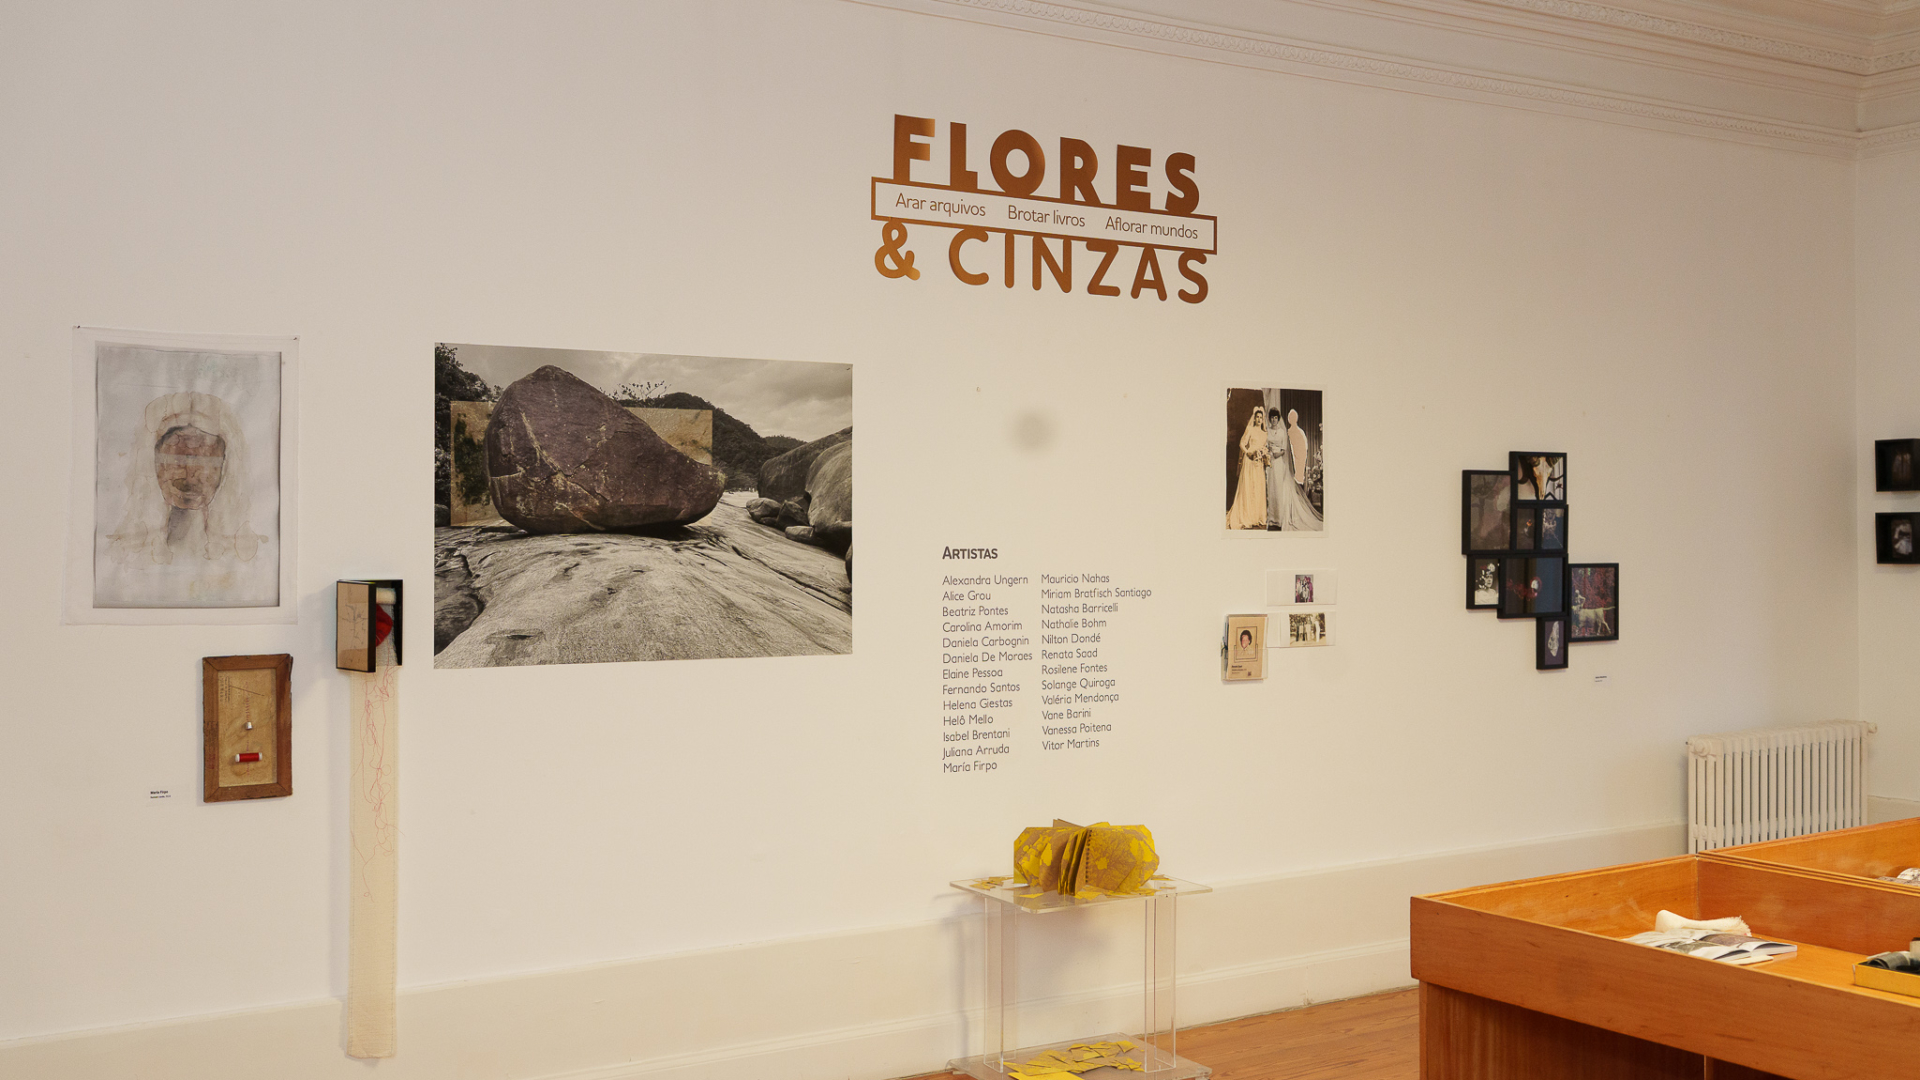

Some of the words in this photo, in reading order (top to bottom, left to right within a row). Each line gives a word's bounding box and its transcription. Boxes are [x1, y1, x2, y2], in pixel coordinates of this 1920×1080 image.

[894, 114, 1200, 214] FLORES
[895, 193, 926, 210] Arar
[929, 198, 986, 218] arquivos
[1008, 205, 1050, 223] Brotar
[1053, 209, 1085, 227] livros
[1105, 216, 1147, 234] Aflorar
[1150, 223, 1198, 240] mundos
[874, 220, 921, 281] &
[949, 228, 1209, 304] CINZAS
[942, 575, 990, 585] Alexandra
[994, 575, 1028, 587] Ungern
[1082, 573, 1109, 583] Nahas
[942, 591, 964, 601] Alice
[967, 590, 991, 600] Grou
[1041, 589, 1071, 599] Miriam
[1075, 588, 1112, 598] Bratfisch
[1115, 588, 1152, 599] Santiago
[943, 606, 976, 617] Beatriz
[979, 605, 1008, 616] Pontes
[1042, 604, 1079, 614] Natasha
[1082, 603, 1118, 613] Barricelli
[943, 622, 981, 632] Carolina
[984, 620, 1022, 631] Amorim
[1042, 619, 1079, 629] Nathalie
[1082, 618, 1106, 628] Bohm
[943, 637, 978, 648] Daniela
[1042, 634, 1068, 644] Nilton
[1071, 633, 1101, 643] Dondé
[943, 653, 978, 663] Daniela
[982, 652, 995, 662] De
[999, 651, 1032, 661] Moraes
[1042, 650, 1073, 660] Renata
[1076, 648, 1097, 658] Saad
[943, 669, 969, 679] Elaine
[972, 668, 1003, 678] Pessoa
[1042, 664, 1077, 675] Rosilene
[1080, 663, 1107, 673] Fontes
[943, 683, 987, 695] Fernando
[990, 682, 1020, 692] Santos
[1042, 680, 1077, 691] Solange
[1080, 678, 1115, 689] Quiroga
[943, 700, 976, 710] Helena
[979, 698, 1013, 708] Giestas
[1041, 694, 1072, 705] Valéria
[1075, 693, 1119, 703] Mendonça
[944, 715, 965, 726] Helô
[969, 714, 993, 724] Mello
[1042, 710, 1063, 720] Vane
[1067, 708, 1091, 719] Barini
[943, 731, 969, 742] Isabel
[973, 728, 1010, 740] Brentani
[1042, 726, 1077, 735] Vanessa
[1080, 723, 1111, 733] Poitena
[1042, 741, 1064, 750] Vitor
[1067, 738, 1099, 749] Martins
[942, 748, 973, 761] Juliana
[976, 744, 1009, 755] Arruda
[974, 760, 997, 773] Firpo
